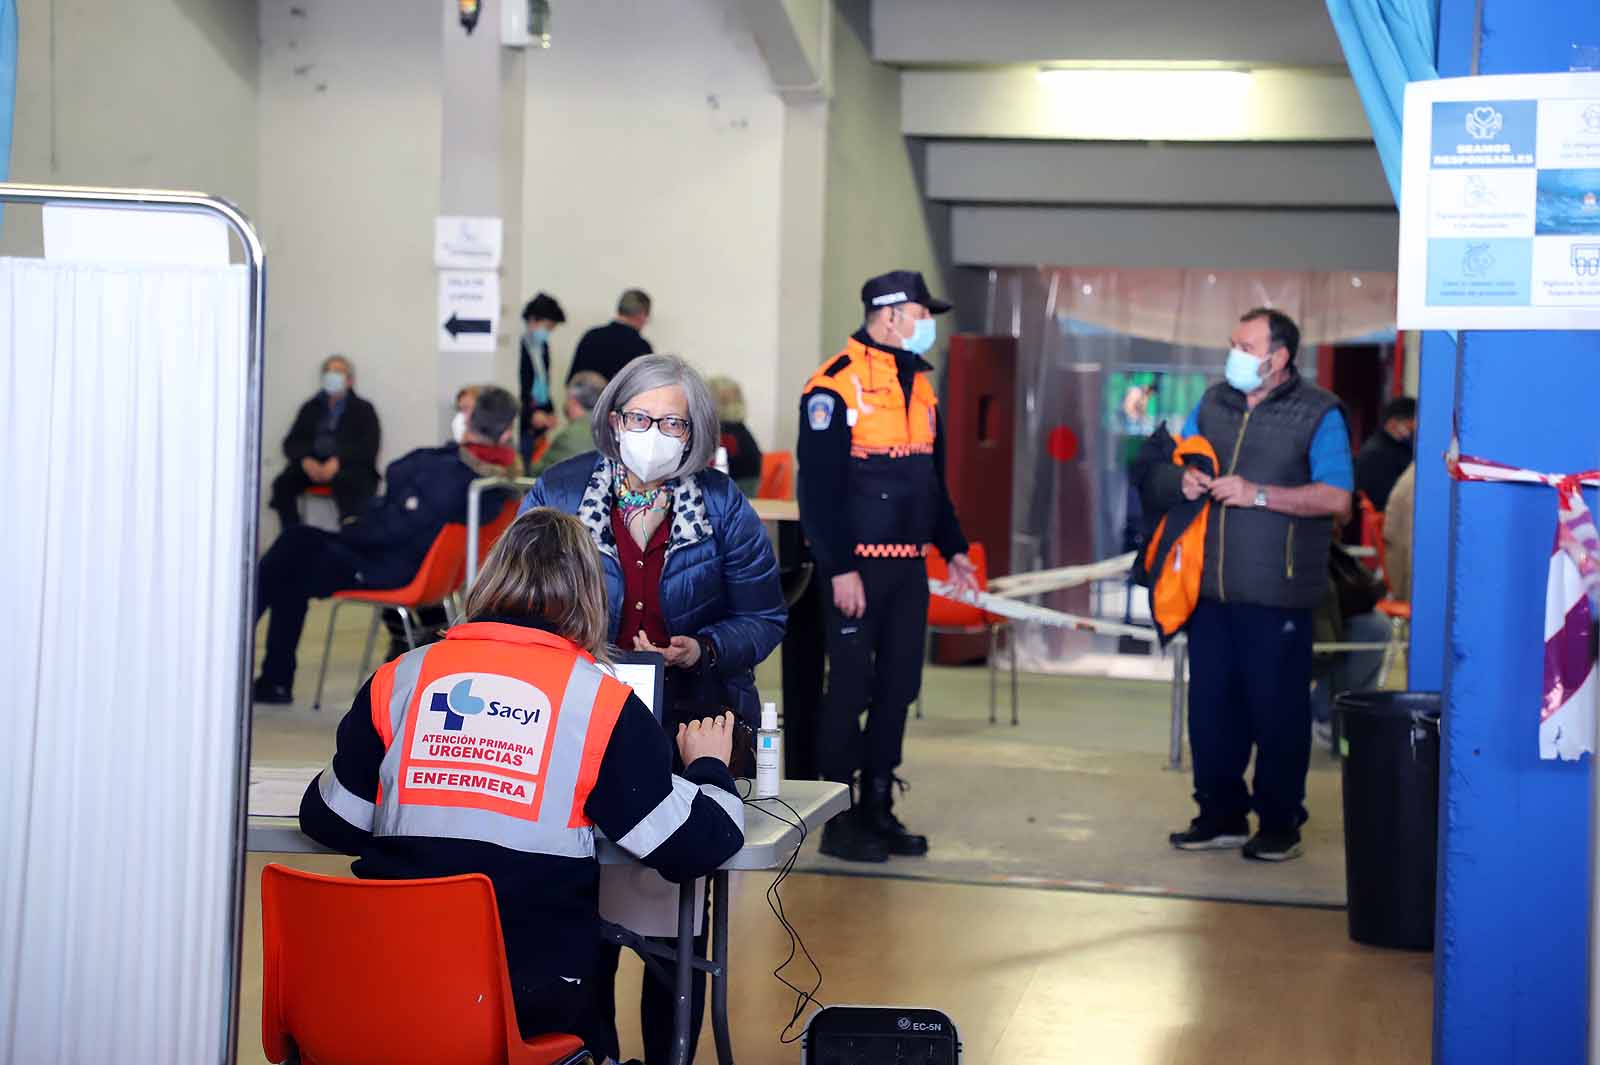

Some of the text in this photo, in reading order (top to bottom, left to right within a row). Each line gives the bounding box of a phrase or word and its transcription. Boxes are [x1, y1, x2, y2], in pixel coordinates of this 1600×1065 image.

[487, 701, 540, 726] Sacyl
[422, 734, 534, 756] ATENCIÓN PRIMARIA
[429, 745, 524, 766] URGENCIAS
[413, 772, 526, 798] ENFERMERA
[912, 1022, 942, 1032] EC-5N
